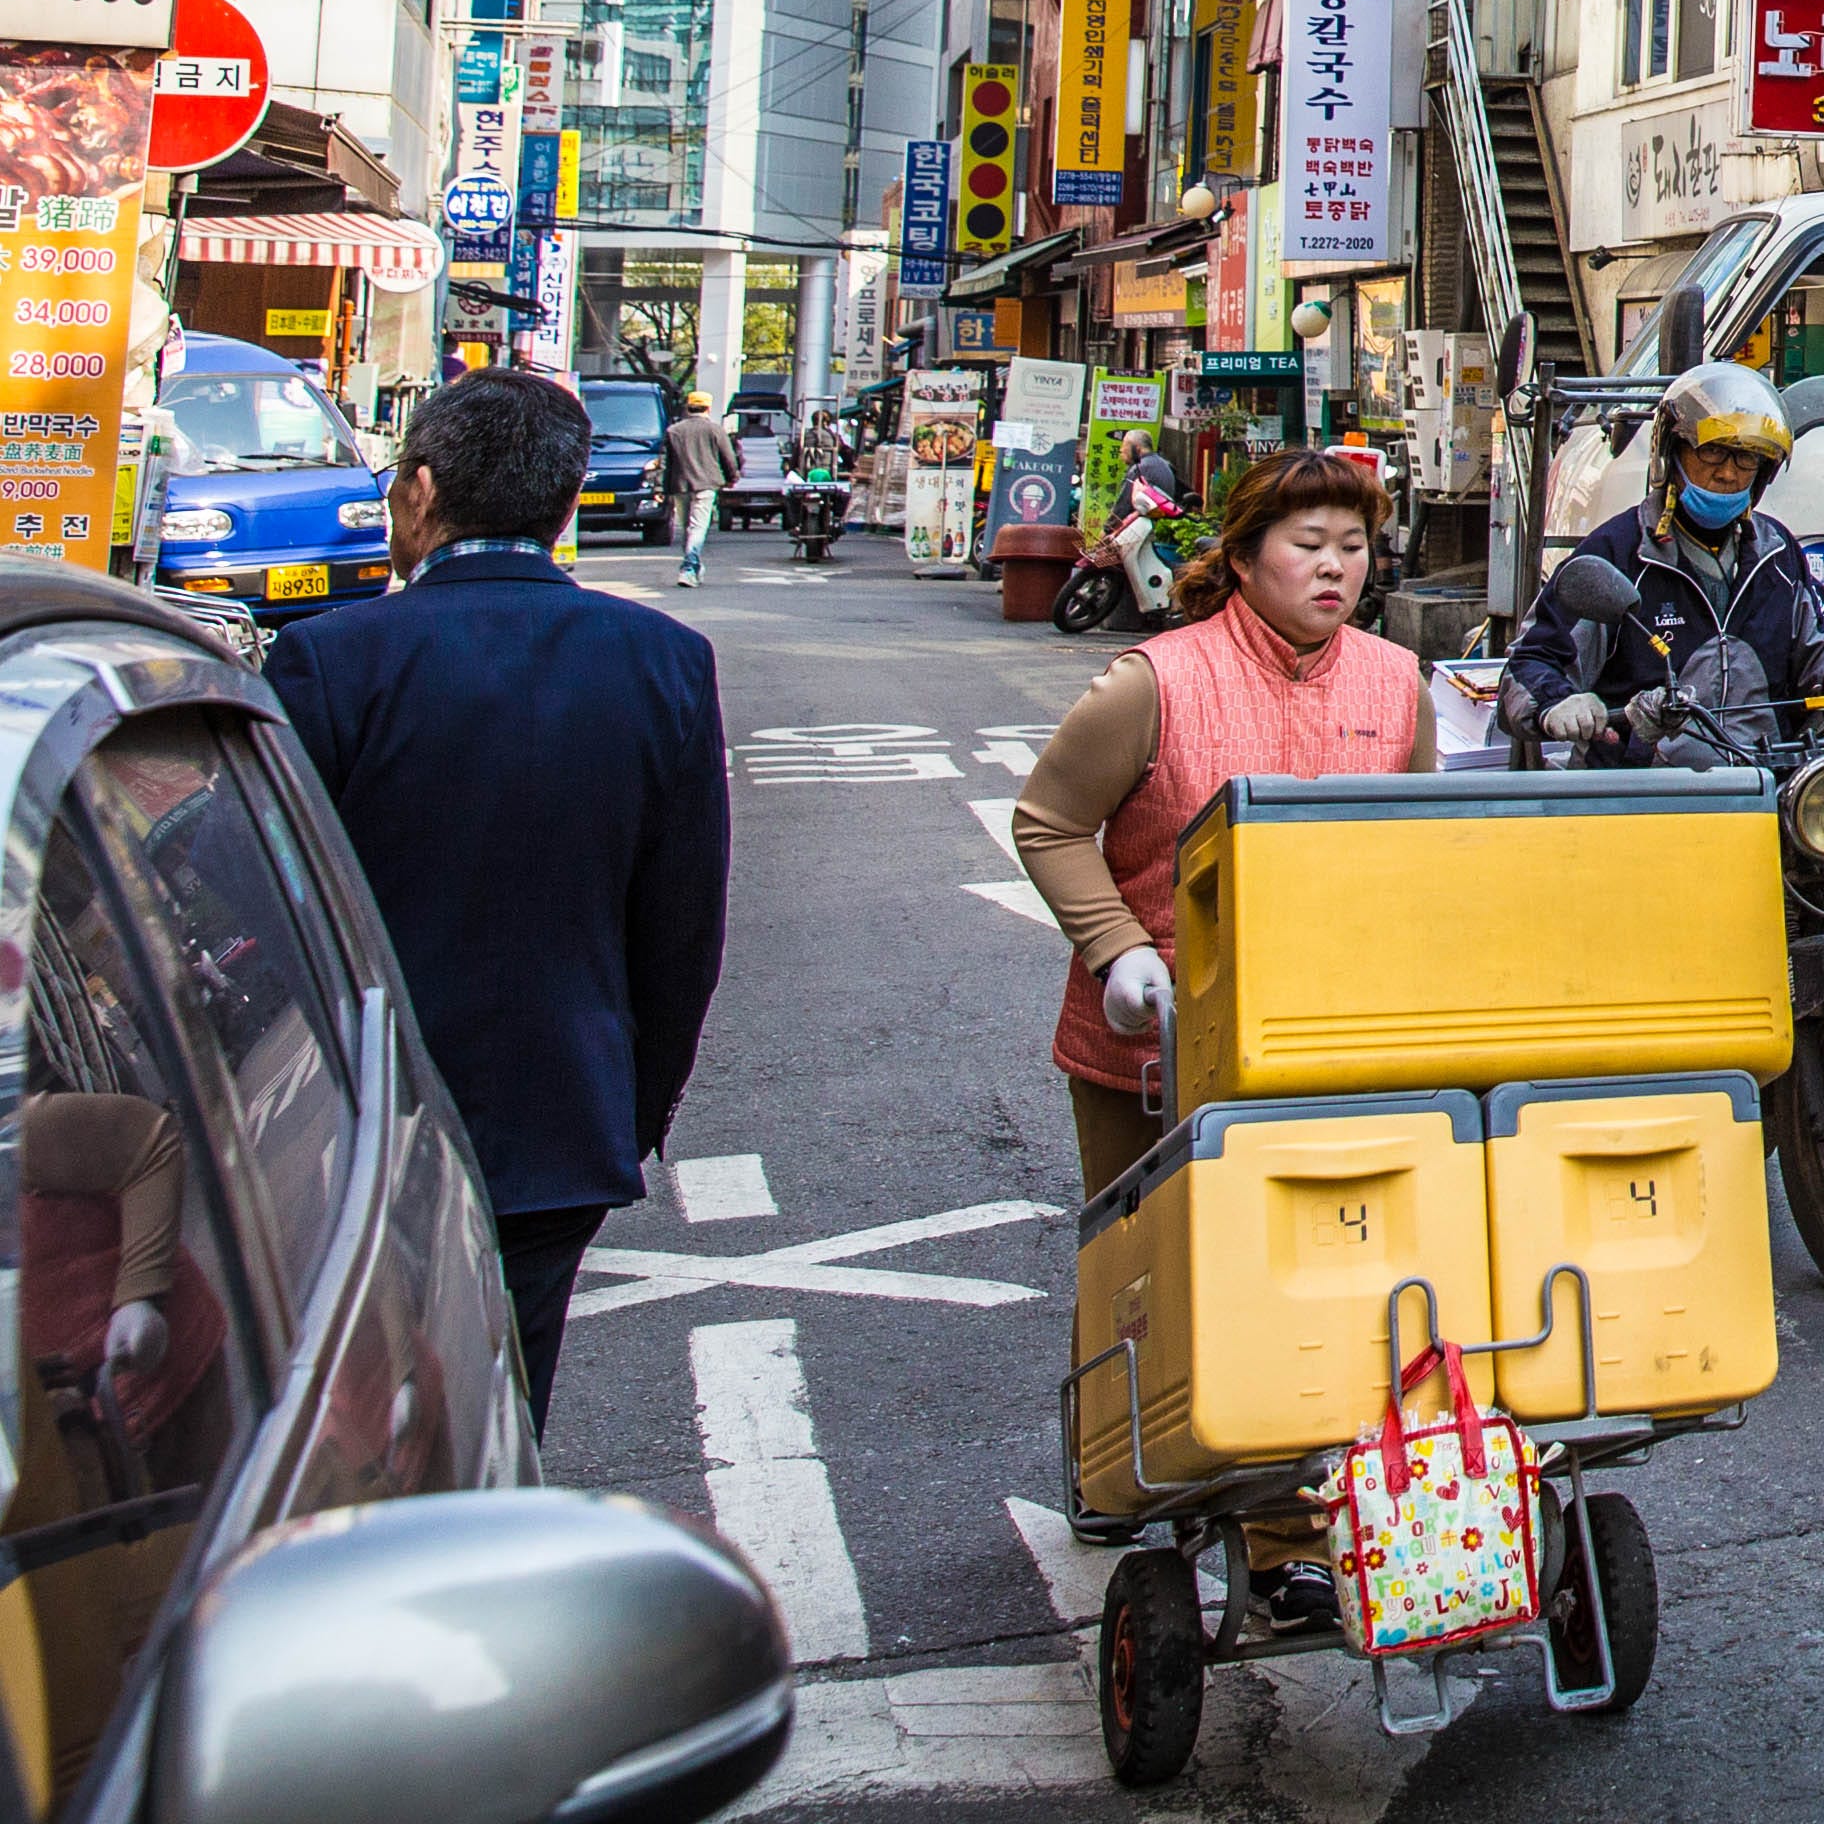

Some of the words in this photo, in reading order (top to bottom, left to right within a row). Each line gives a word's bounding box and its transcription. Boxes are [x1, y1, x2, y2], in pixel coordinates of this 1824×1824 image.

[39, 196, 117, 232] 猪蹄
[1304, 200, 1371, 222] 토종닭
[1300, 235, 1375, 250] T.2272-2020
[22, 247, 115, 273] 39,000
[16, 300, 110, 325] 34,000
[10, 353, 105, 378] 28,000
[1206, 357, 1261, 371] 프리미엄
[1269, 357, 1299, 369] TEA
